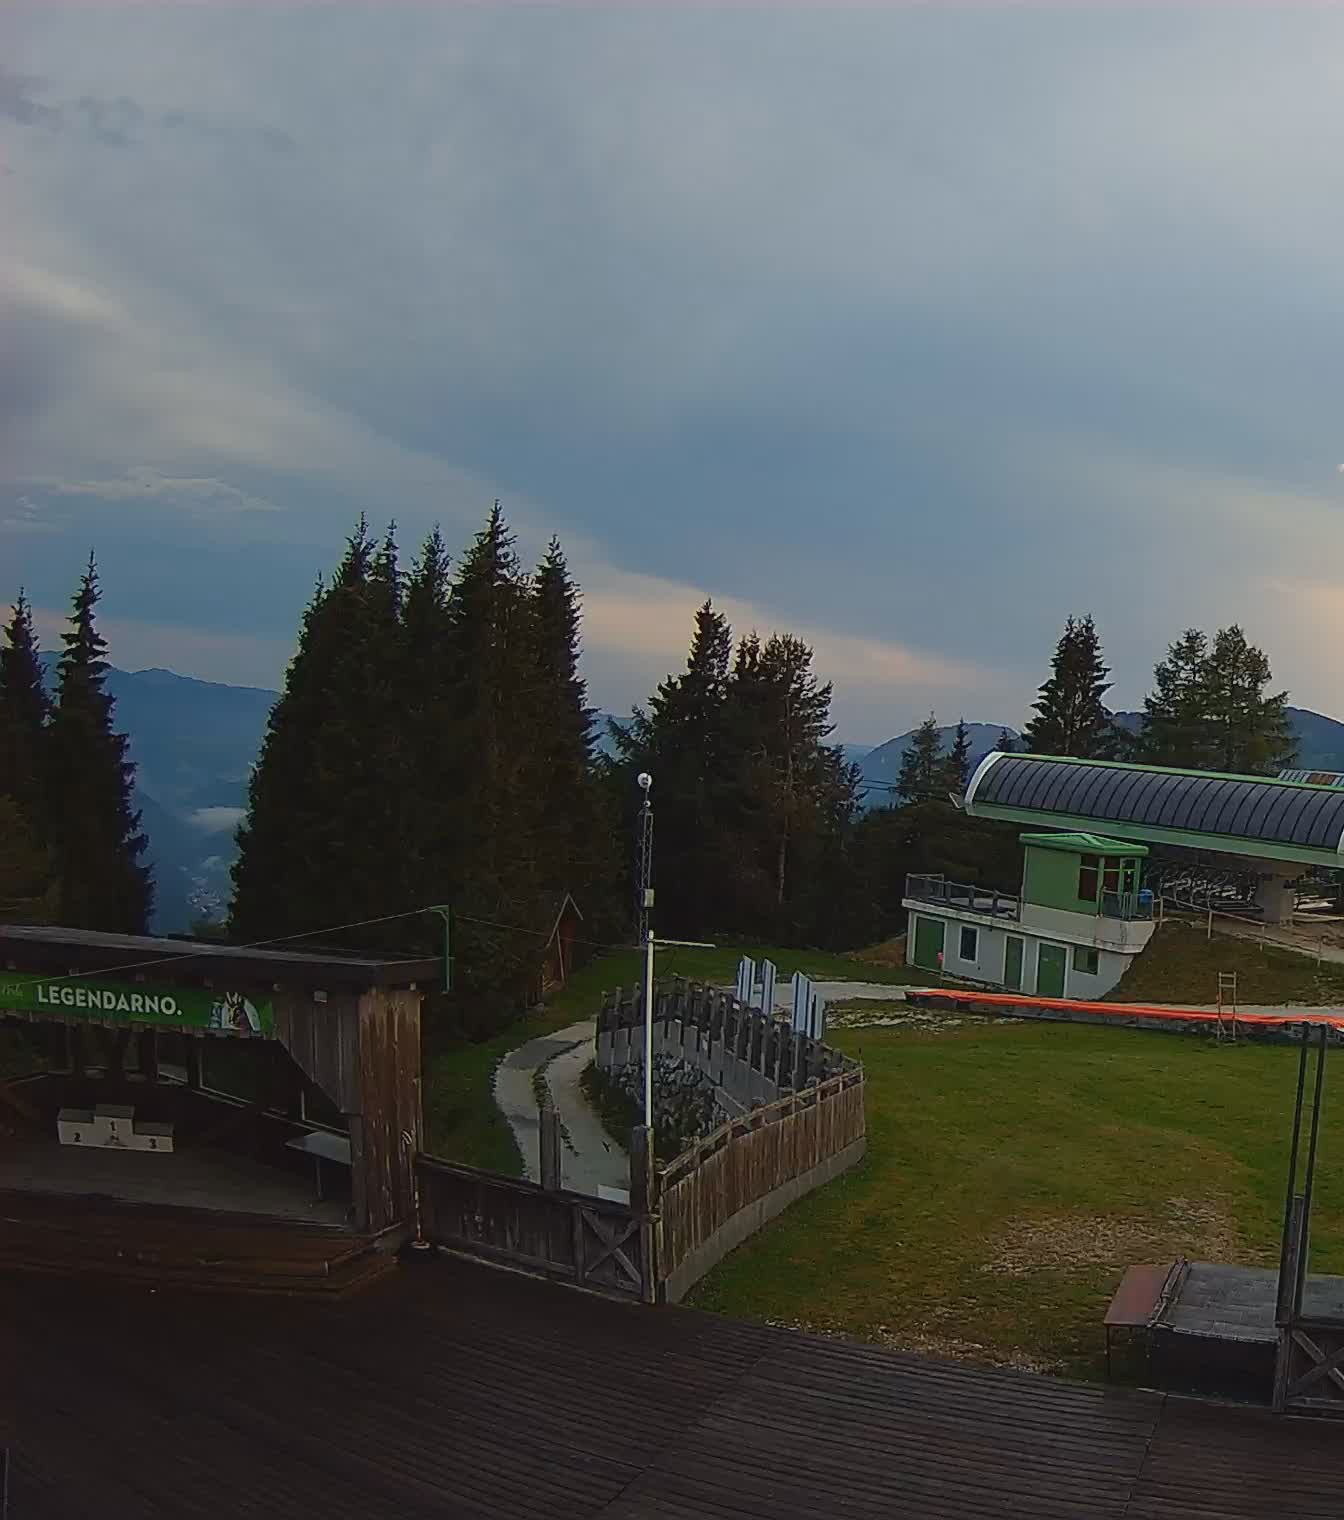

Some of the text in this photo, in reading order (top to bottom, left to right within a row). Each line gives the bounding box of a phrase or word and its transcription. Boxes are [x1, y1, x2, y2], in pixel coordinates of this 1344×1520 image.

[37, 984, 182, 1016] LEGENDARNO.
[73, 1133, 81, 1143] 2
[149, 1138, 157, 1149] 3
